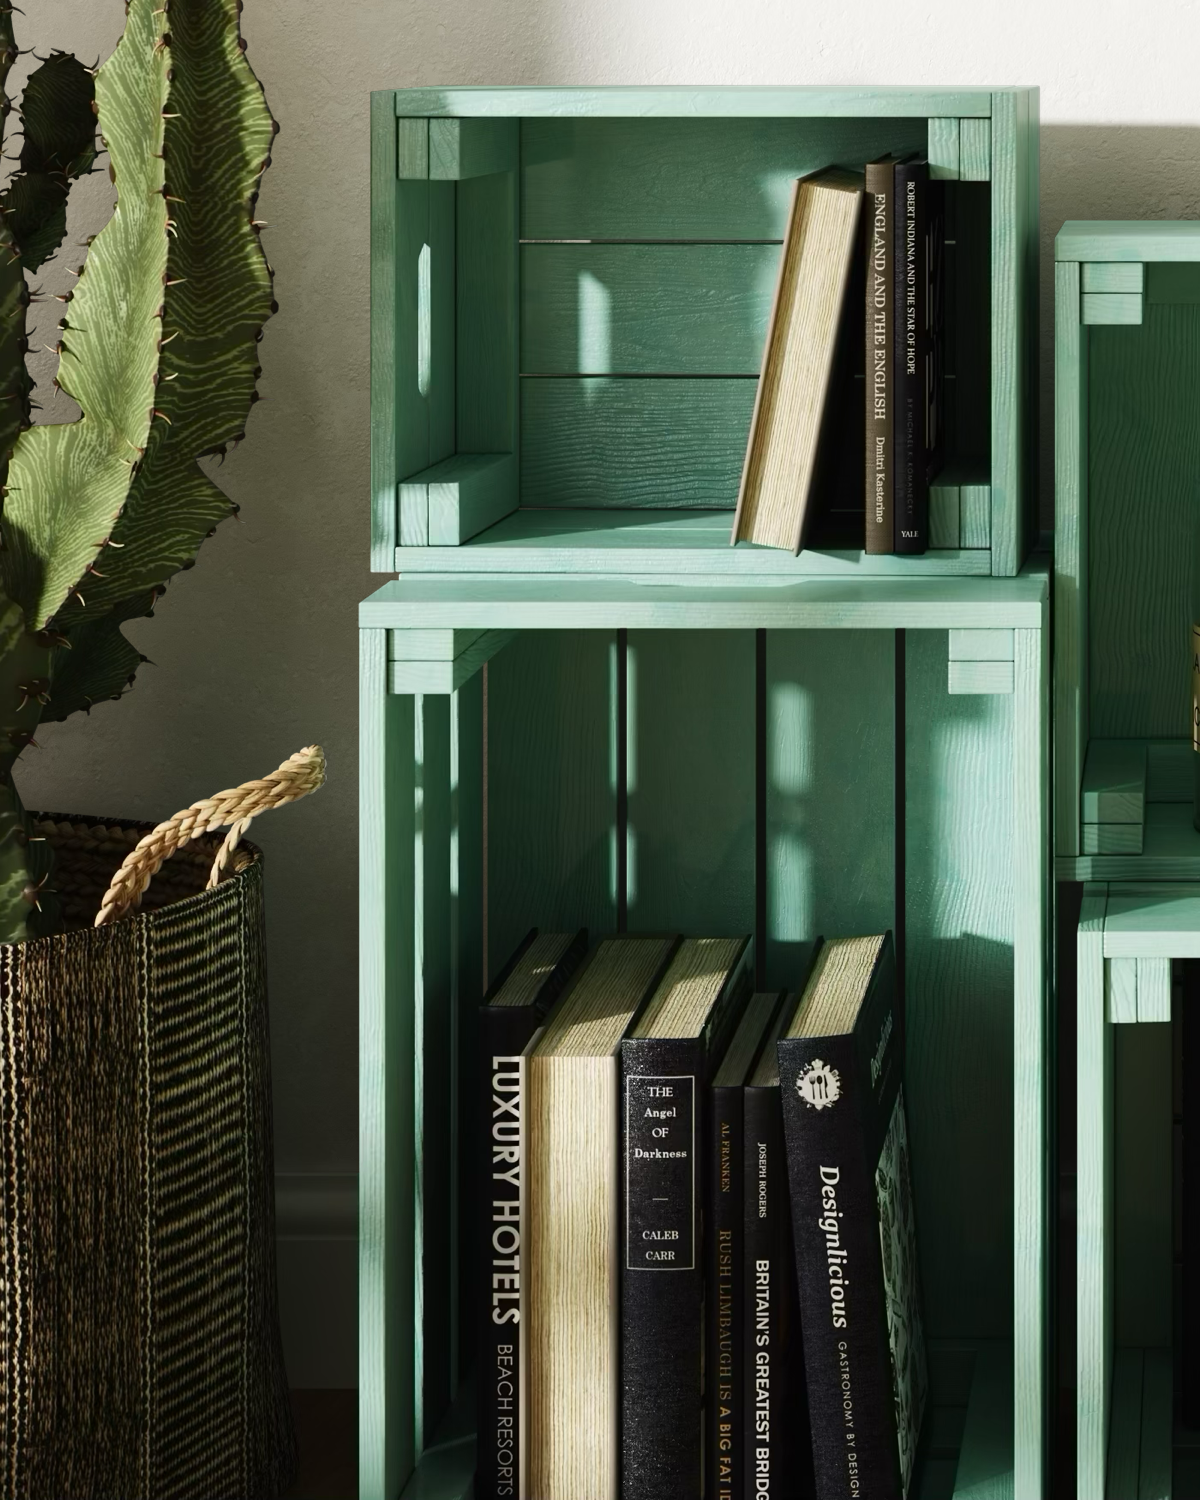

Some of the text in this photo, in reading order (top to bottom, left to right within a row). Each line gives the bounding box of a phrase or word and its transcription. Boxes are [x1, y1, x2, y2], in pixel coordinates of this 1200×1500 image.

[906, 180, 916, 375] ROBERT INDIANA AND THE STAR OF HOPE
[873, 193, 886, 420] ENGLAND AND THE ENGLISH
[875, 436, 886, 524] Dmitri Kasterine
[901, 530, 919, 539] YALE
[644, 1107, 677, 1119] Angel
[647, 1087, 674, 1097] THE
[634, 1148, 687, 1159] Darkness
[652, 1127, 669, 1138] OF
[721, 1122, 731, 1193] AL FRANKEN
[757, 1143, 767, 1218] JOSEPH ROGERS
[492, 1056, 520, 1325] LUXURY HOTELS
[642, 1230, 679, 1240] CALEB
[645, 1251, 675, 1260] CARR
[719, 1230, 732, 1277] RUSH
[818, 1165, 850, 1329] Designlicious
[719, 1284, 732, 1377] LIMBAUGH
[719, 1384, 732, 1400] IS
[719, 1406, 731, 1417] A
[755, 1352, 770, 1442] GREATEST
[497, 1344, 514, 1497] BEACH RESORTS
[719, 1424, 732, 1450] BIG
[838, 1342, 860, 1498] GASTRONOMY BY DESIGN
[719, 1457, 732, 1483] FAT
